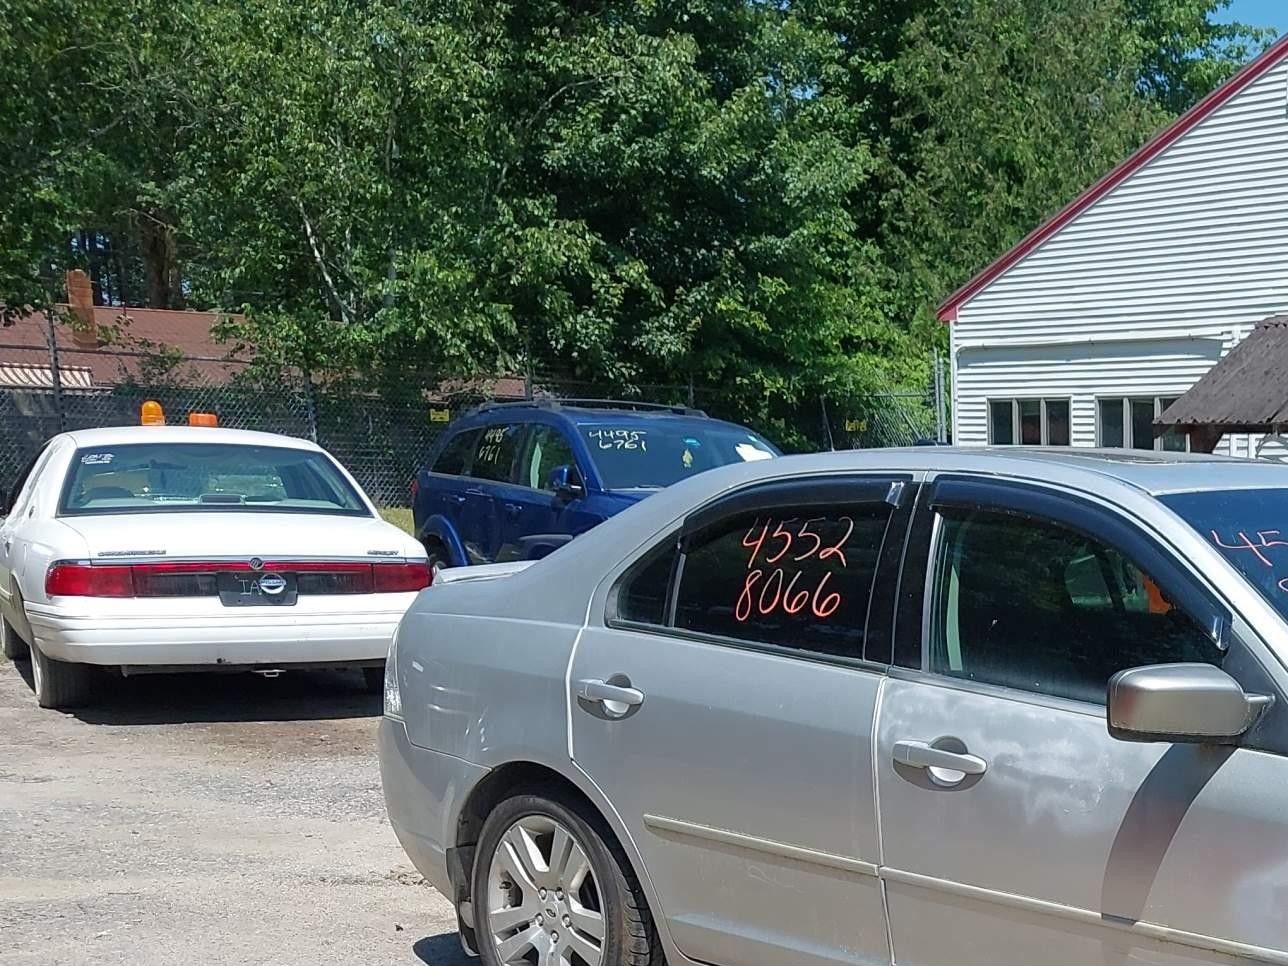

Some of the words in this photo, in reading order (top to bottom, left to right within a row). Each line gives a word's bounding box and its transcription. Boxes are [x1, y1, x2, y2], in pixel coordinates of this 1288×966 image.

[588, 429, 648, 441] 4495
[599, 439, 647, 452] 6761
[741, 516, 855, 569] 4552
[735, 568, 841, 622] 8066
